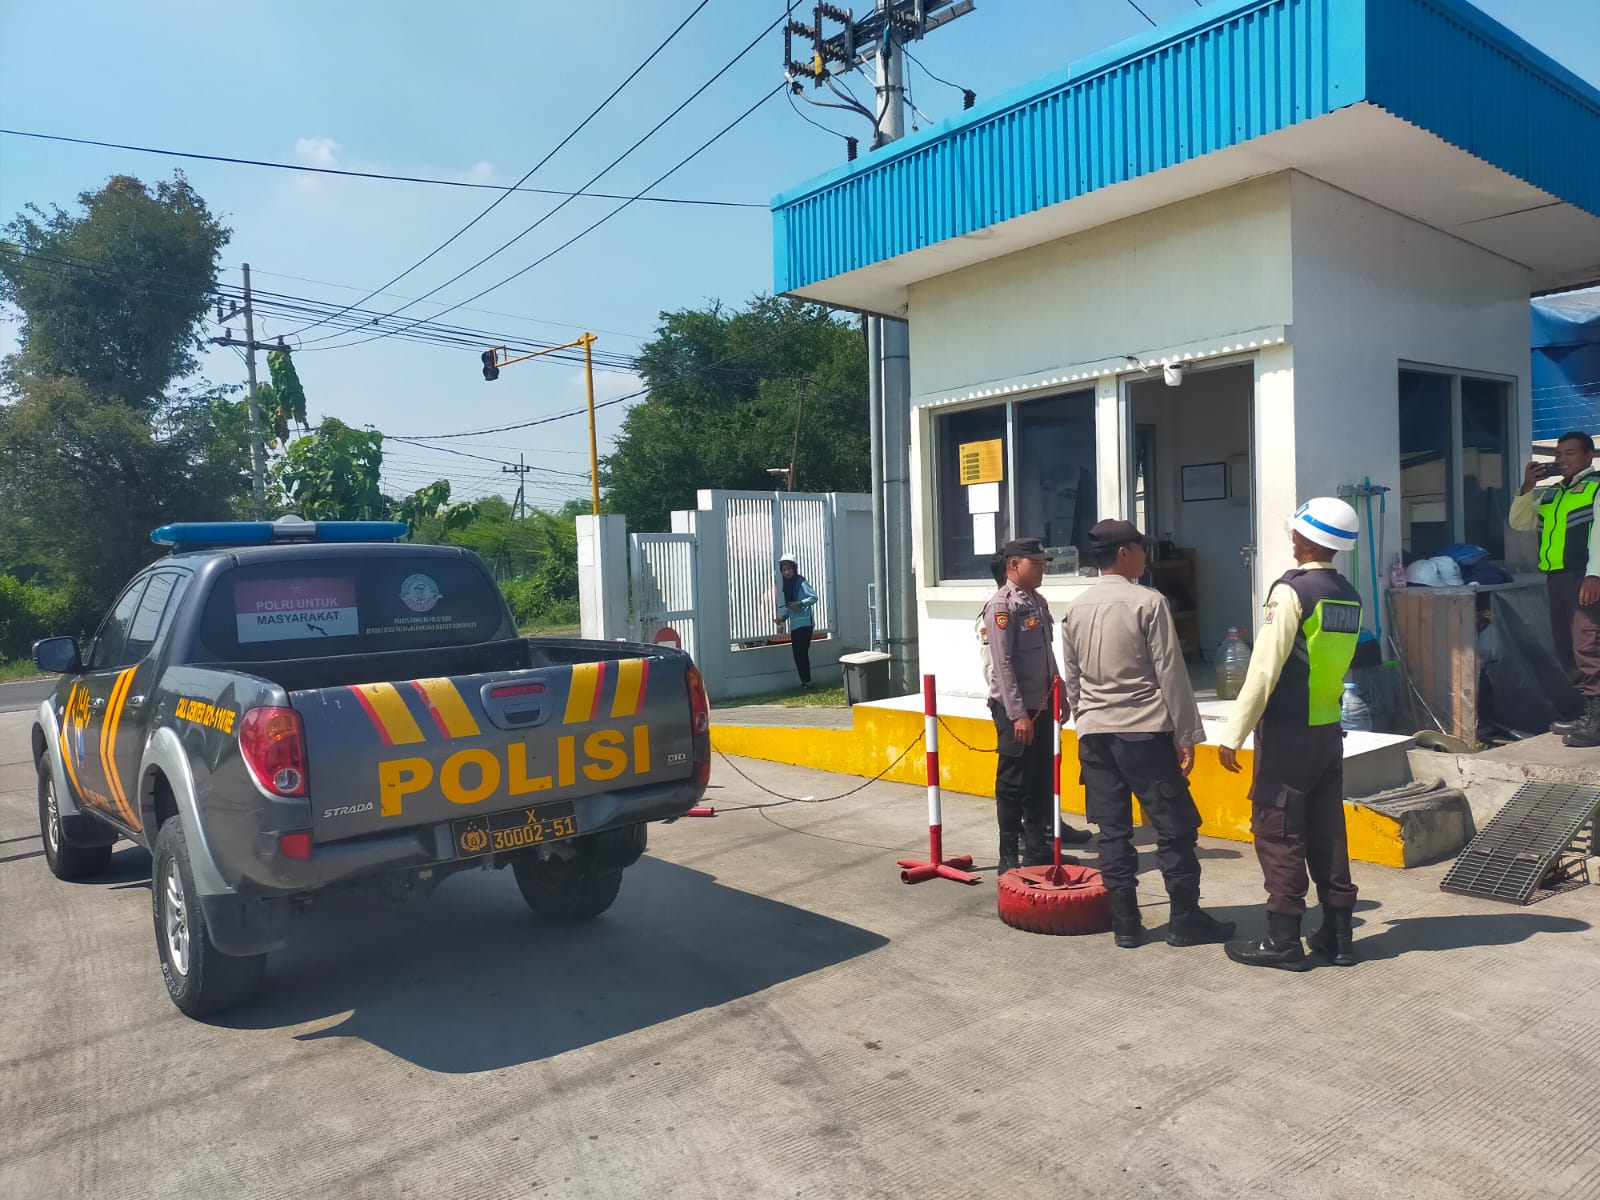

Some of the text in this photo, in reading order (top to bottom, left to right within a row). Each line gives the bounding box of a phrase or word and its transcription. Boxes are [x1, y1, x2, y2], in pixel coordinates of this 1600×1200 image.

[256, 598, 338, 611] POLRI UNTUK
[257, 611, 340, 625] MASYARAKAT
[378, 724, 650, 817] POLISI
[323, 802, 373, 818] STRADA
[525, 809, 536, 824] X
[493, 817, 575, 850] 30002-51
